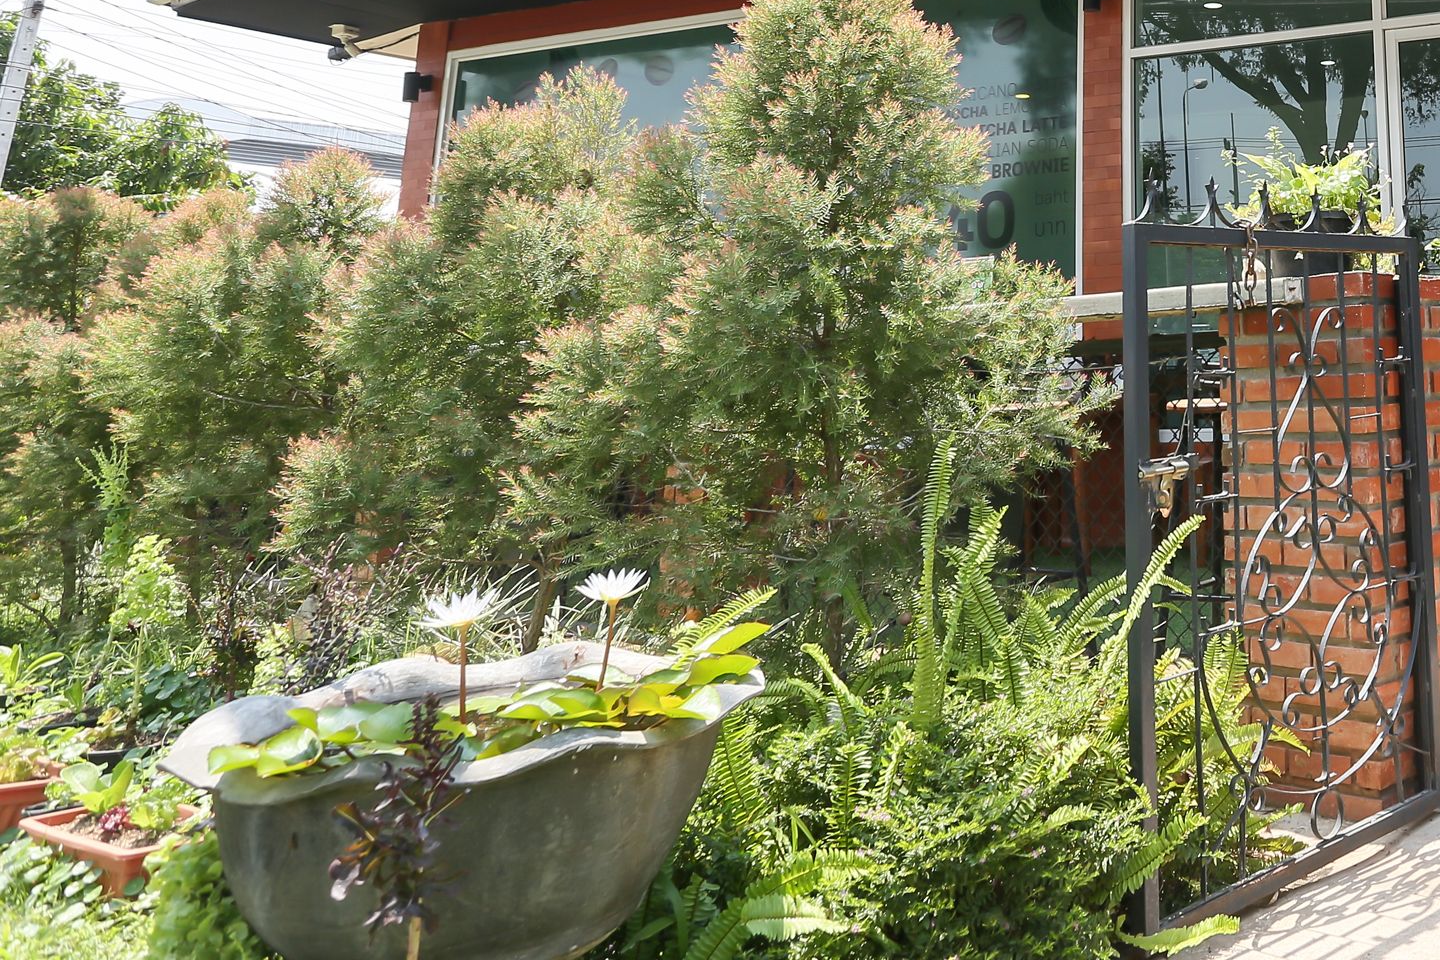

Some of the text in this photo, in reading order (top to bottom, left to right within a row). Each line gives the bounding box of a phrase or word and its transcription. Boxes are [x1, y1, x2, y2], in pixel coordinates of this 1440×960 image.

[1022, 116, 1068, 133] LATTE
[1027, 136, 1069, 153] SODA
[991, 157, 1070, 179] BROWNIE
